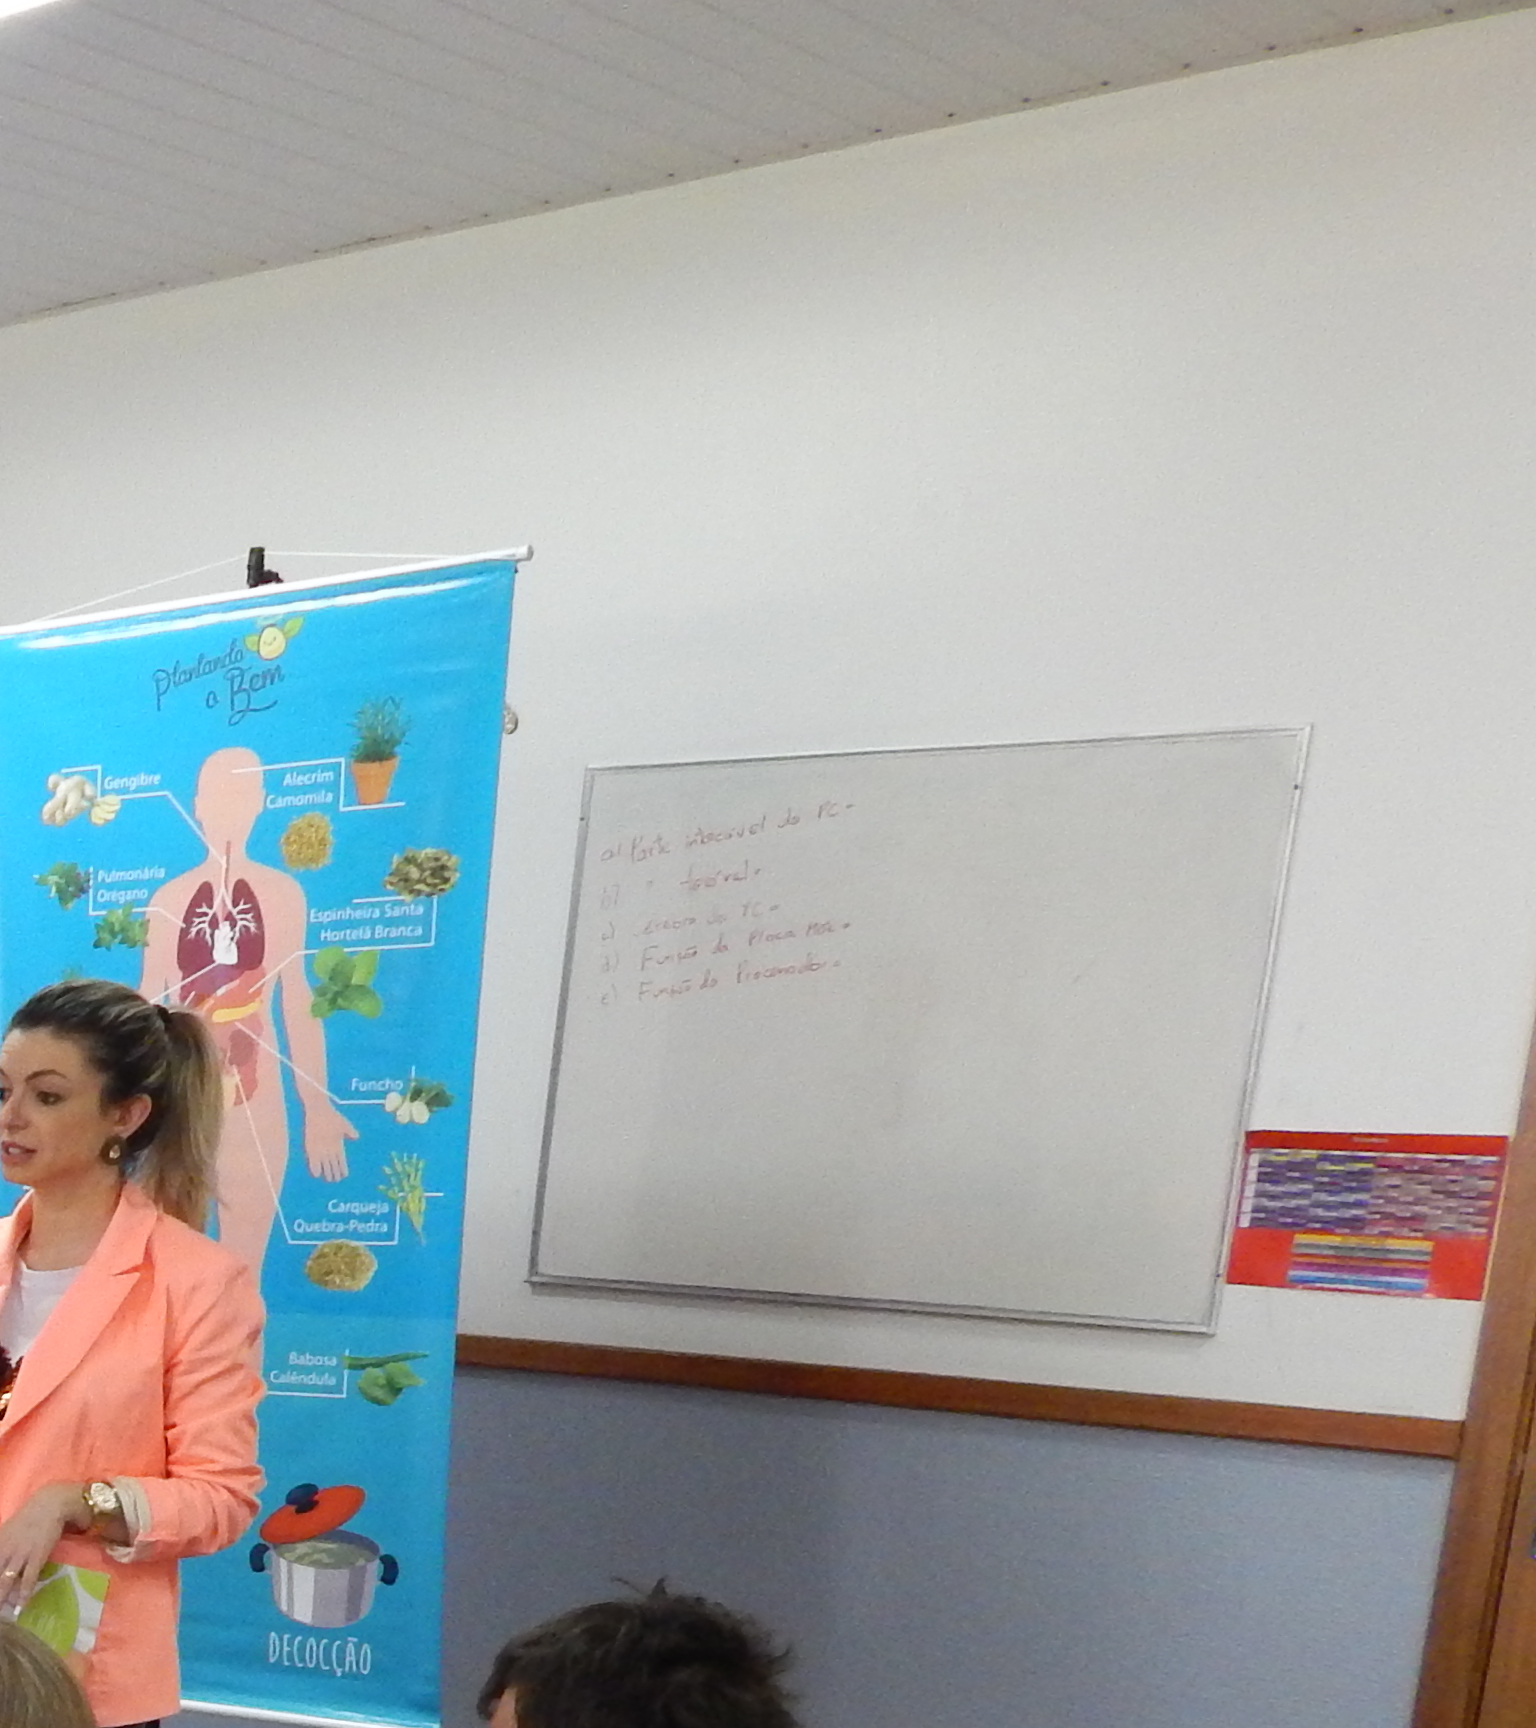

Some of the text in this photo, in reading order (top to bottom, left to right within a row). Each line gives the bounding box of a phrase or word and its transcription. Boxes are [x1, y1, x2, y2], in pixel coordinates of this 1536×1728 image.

[153, 638, 244, 711] Plantando
[224, 665, 285, 726] Bem
[104, 773, 161, 790] Gengibre
[283, 770, 334, 787] Alecrim
[266, 790, 334, 809] Camomila
[97, 866, 165, 883] Pulmonária
[309, 903, 424, 923] Espinheira Santa
[374, 925, 423, 939] Branca
[351, 1077, 404, 1091] Funcho
[328, 1199, 389, 1215] Carqueja
[293, 1219, 388, 1234] Quebra-Pedra
[289, 1351, 337, 1366] Babosa
[270, 1370, 337, 1386] Calêndula
[269, 1631, 371, 1677] DECOCÇÃO
